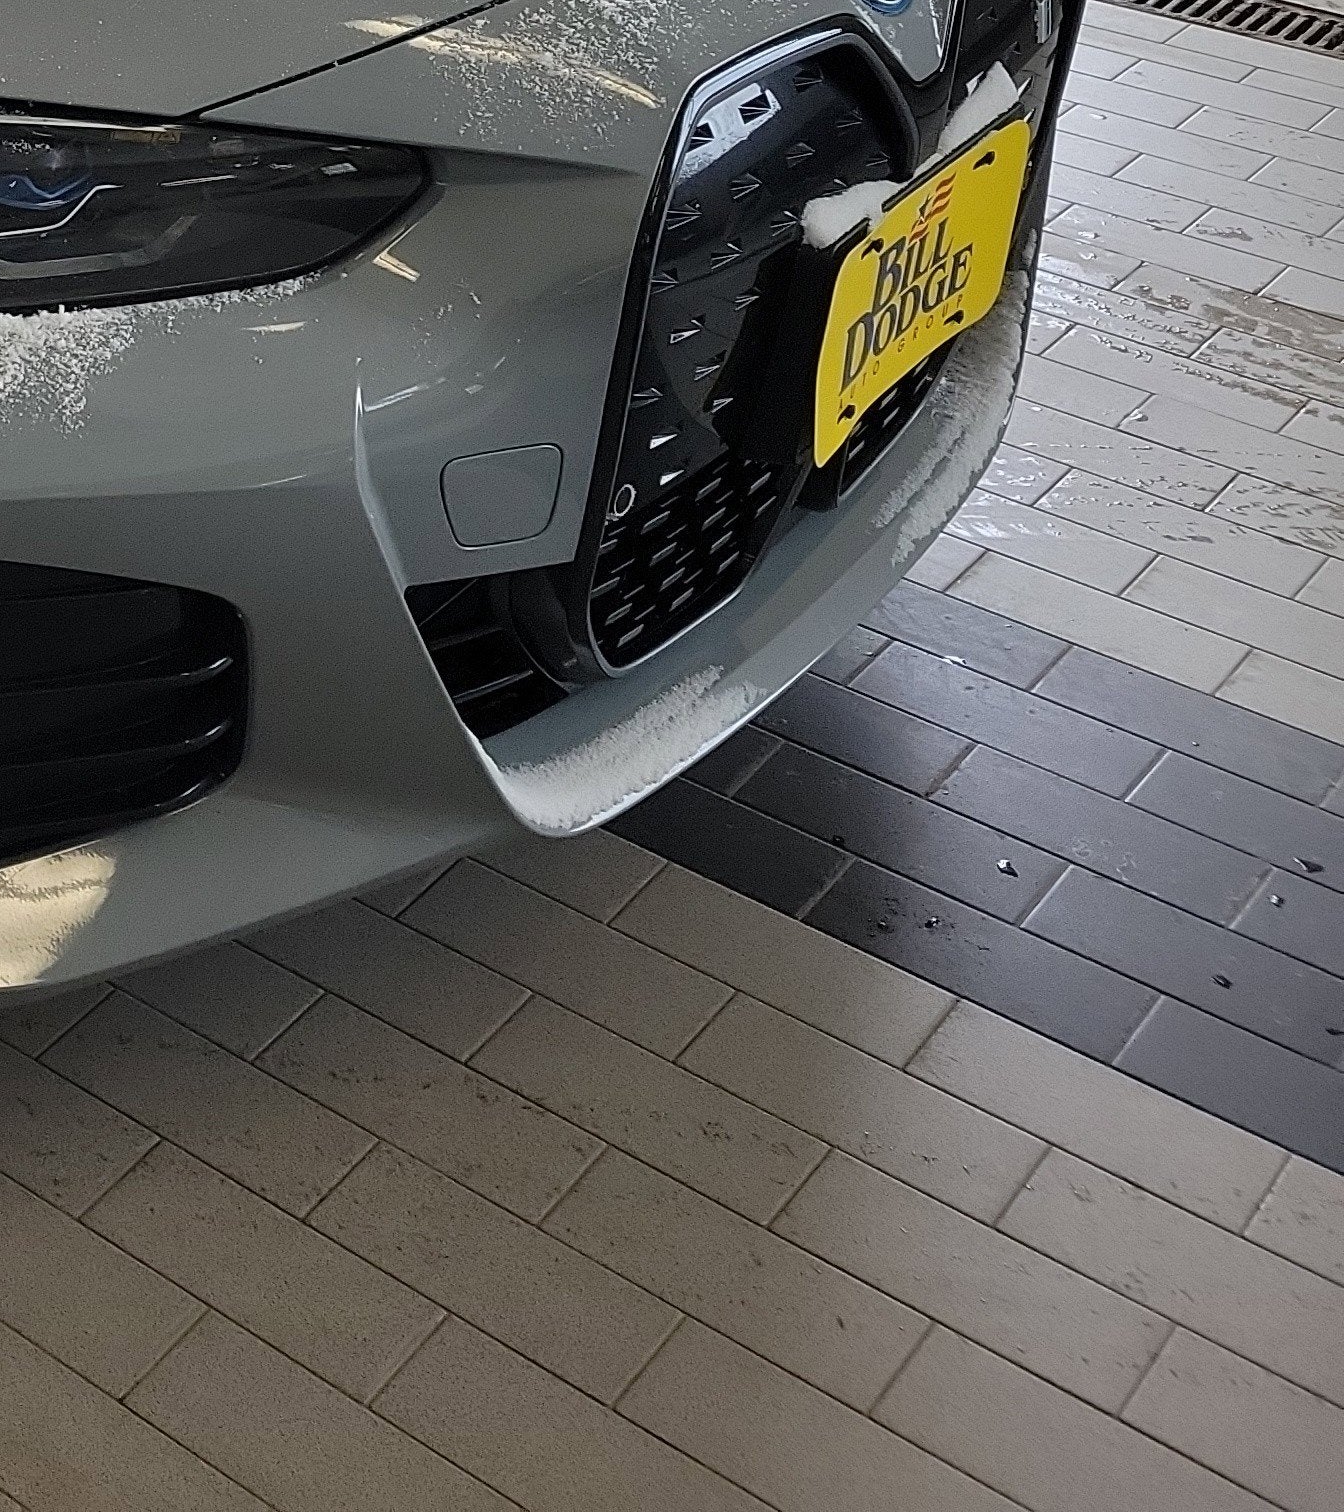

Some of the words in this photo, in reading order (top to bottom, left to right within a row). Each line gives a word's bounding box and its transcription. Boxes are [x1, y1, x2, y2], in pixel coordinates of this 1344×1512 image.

[838, 242, 974, 397] DODGE
[871, 216, 955, 316] BILL
[837, 361, 881, 415] AUTO
[896, 293, 964, 354] GROUP
